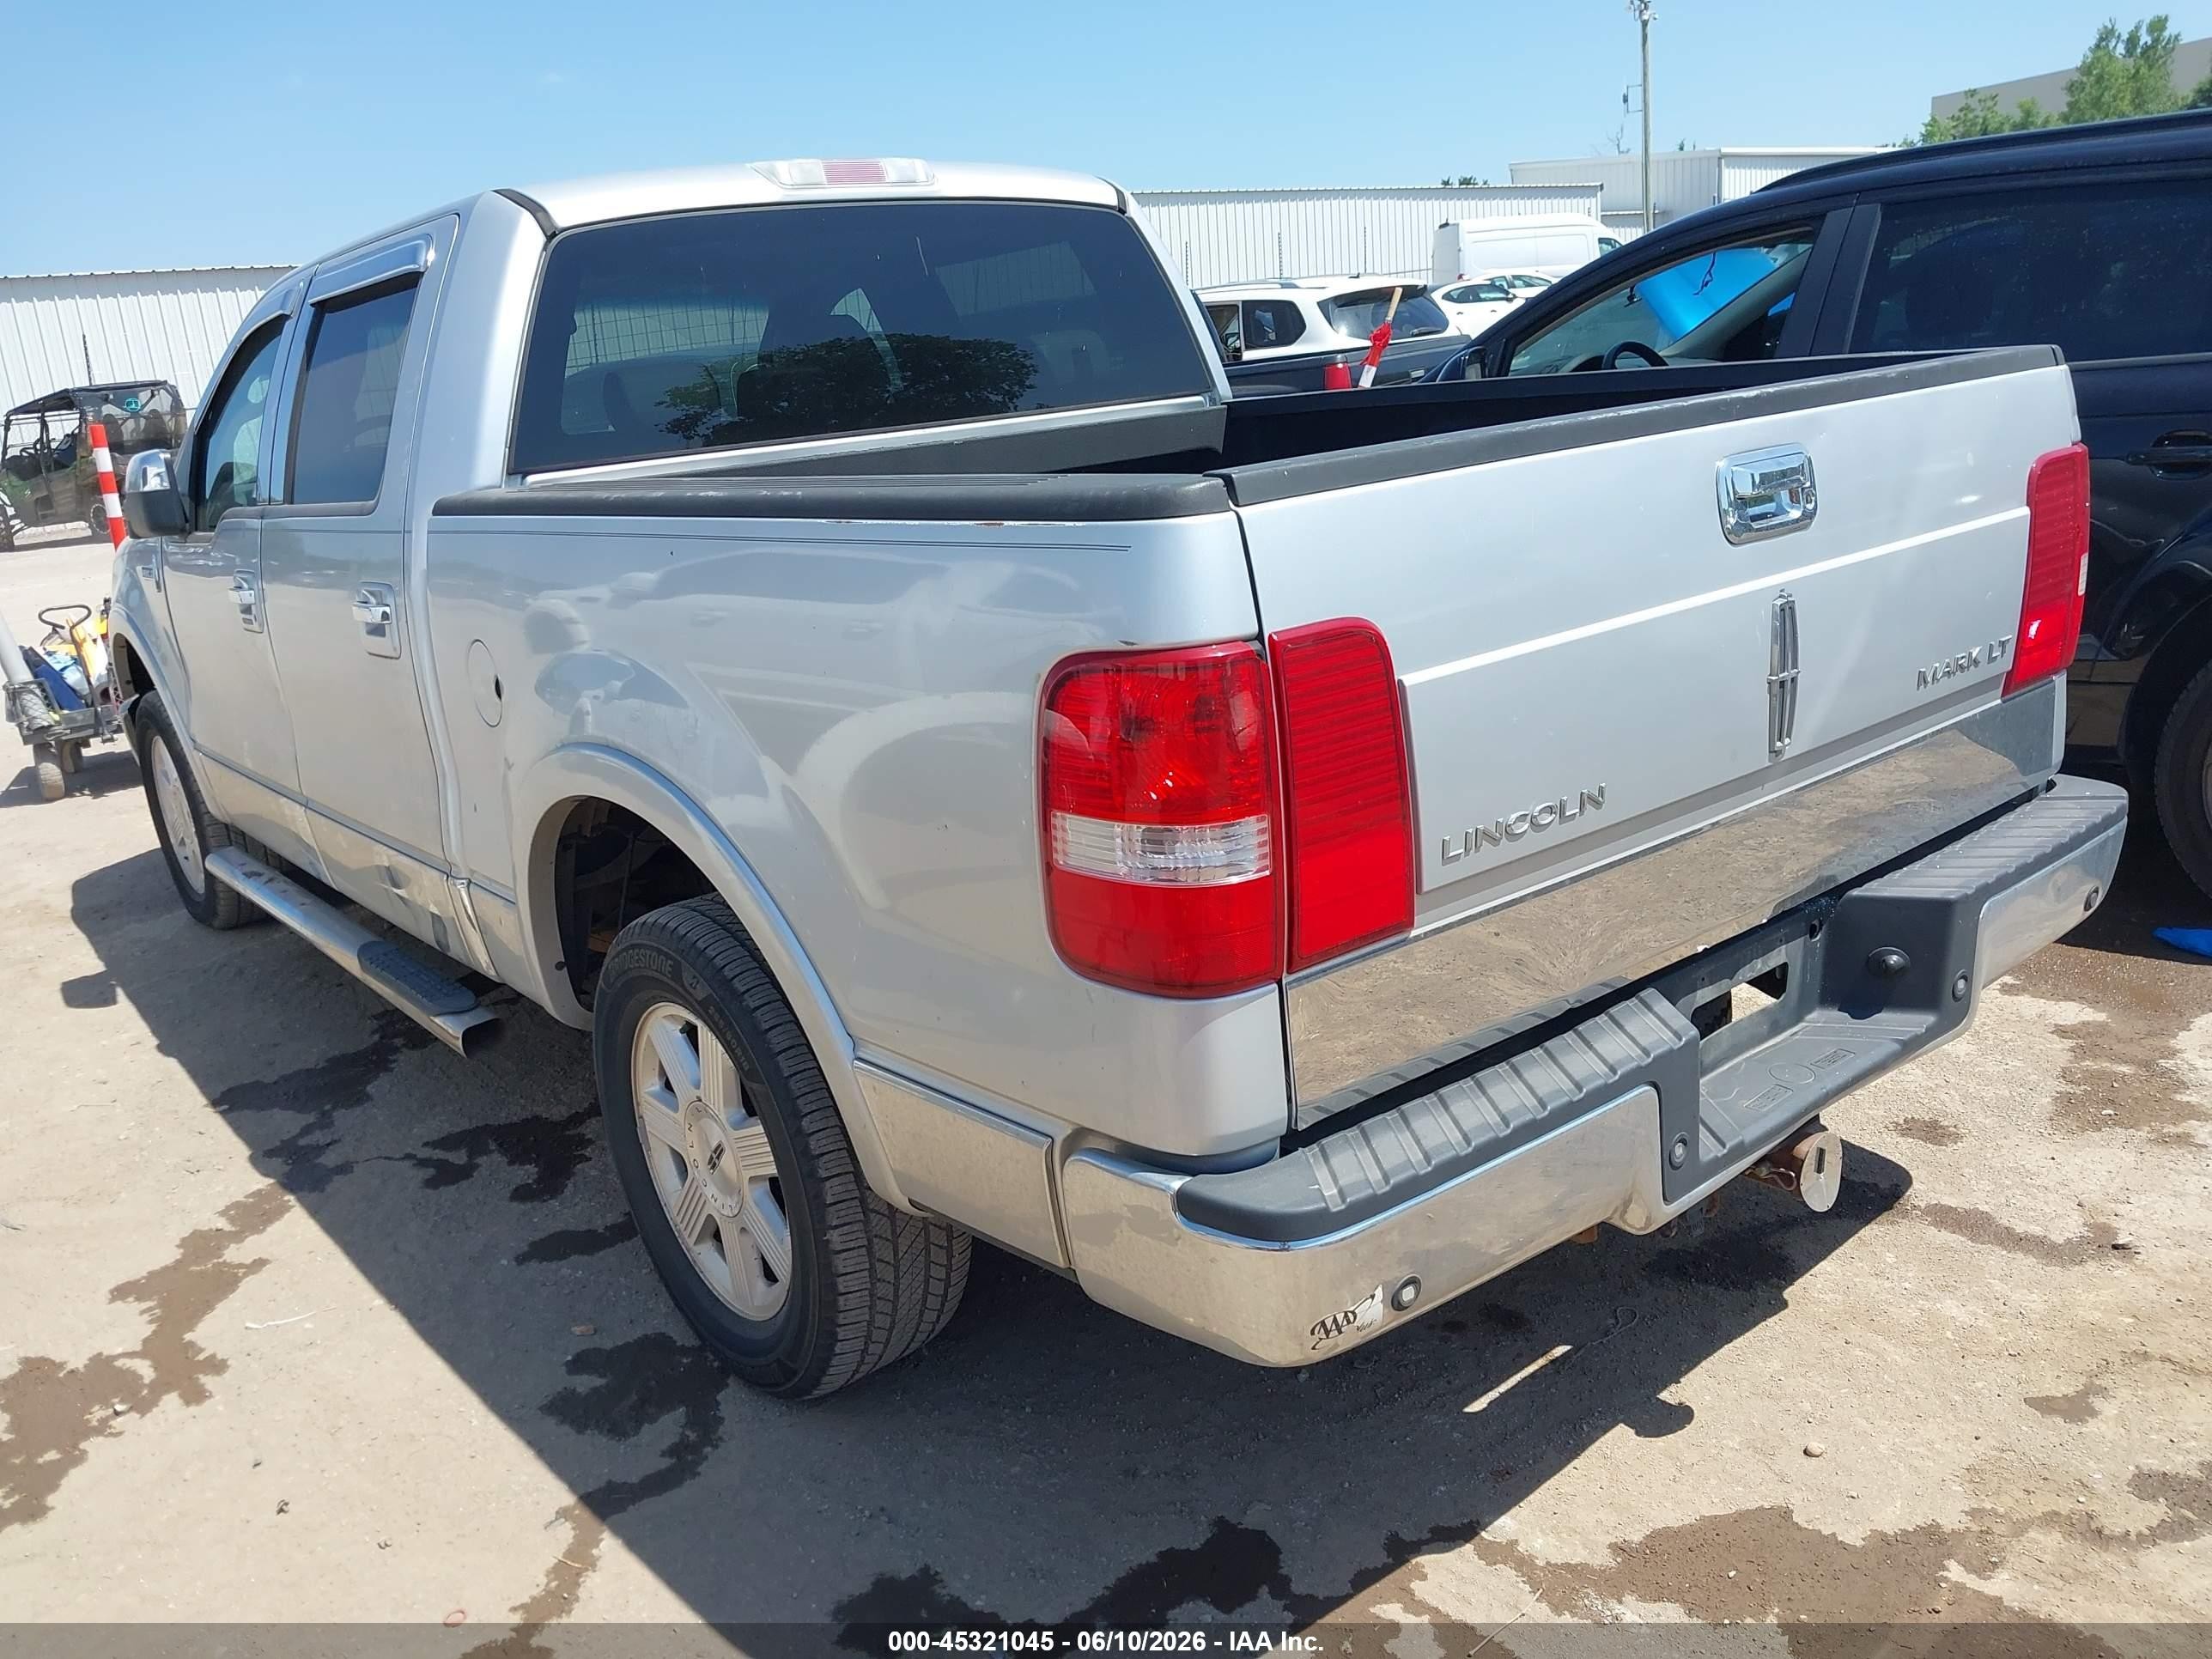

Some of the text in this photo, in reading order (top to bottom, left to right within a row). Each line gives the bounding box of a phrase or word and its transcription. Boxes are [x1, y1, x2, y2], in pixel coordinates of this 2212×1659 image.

[1917, 635, 2013, 691] MARK LT
[1441, 782, 1607, 866] LINCOLN
